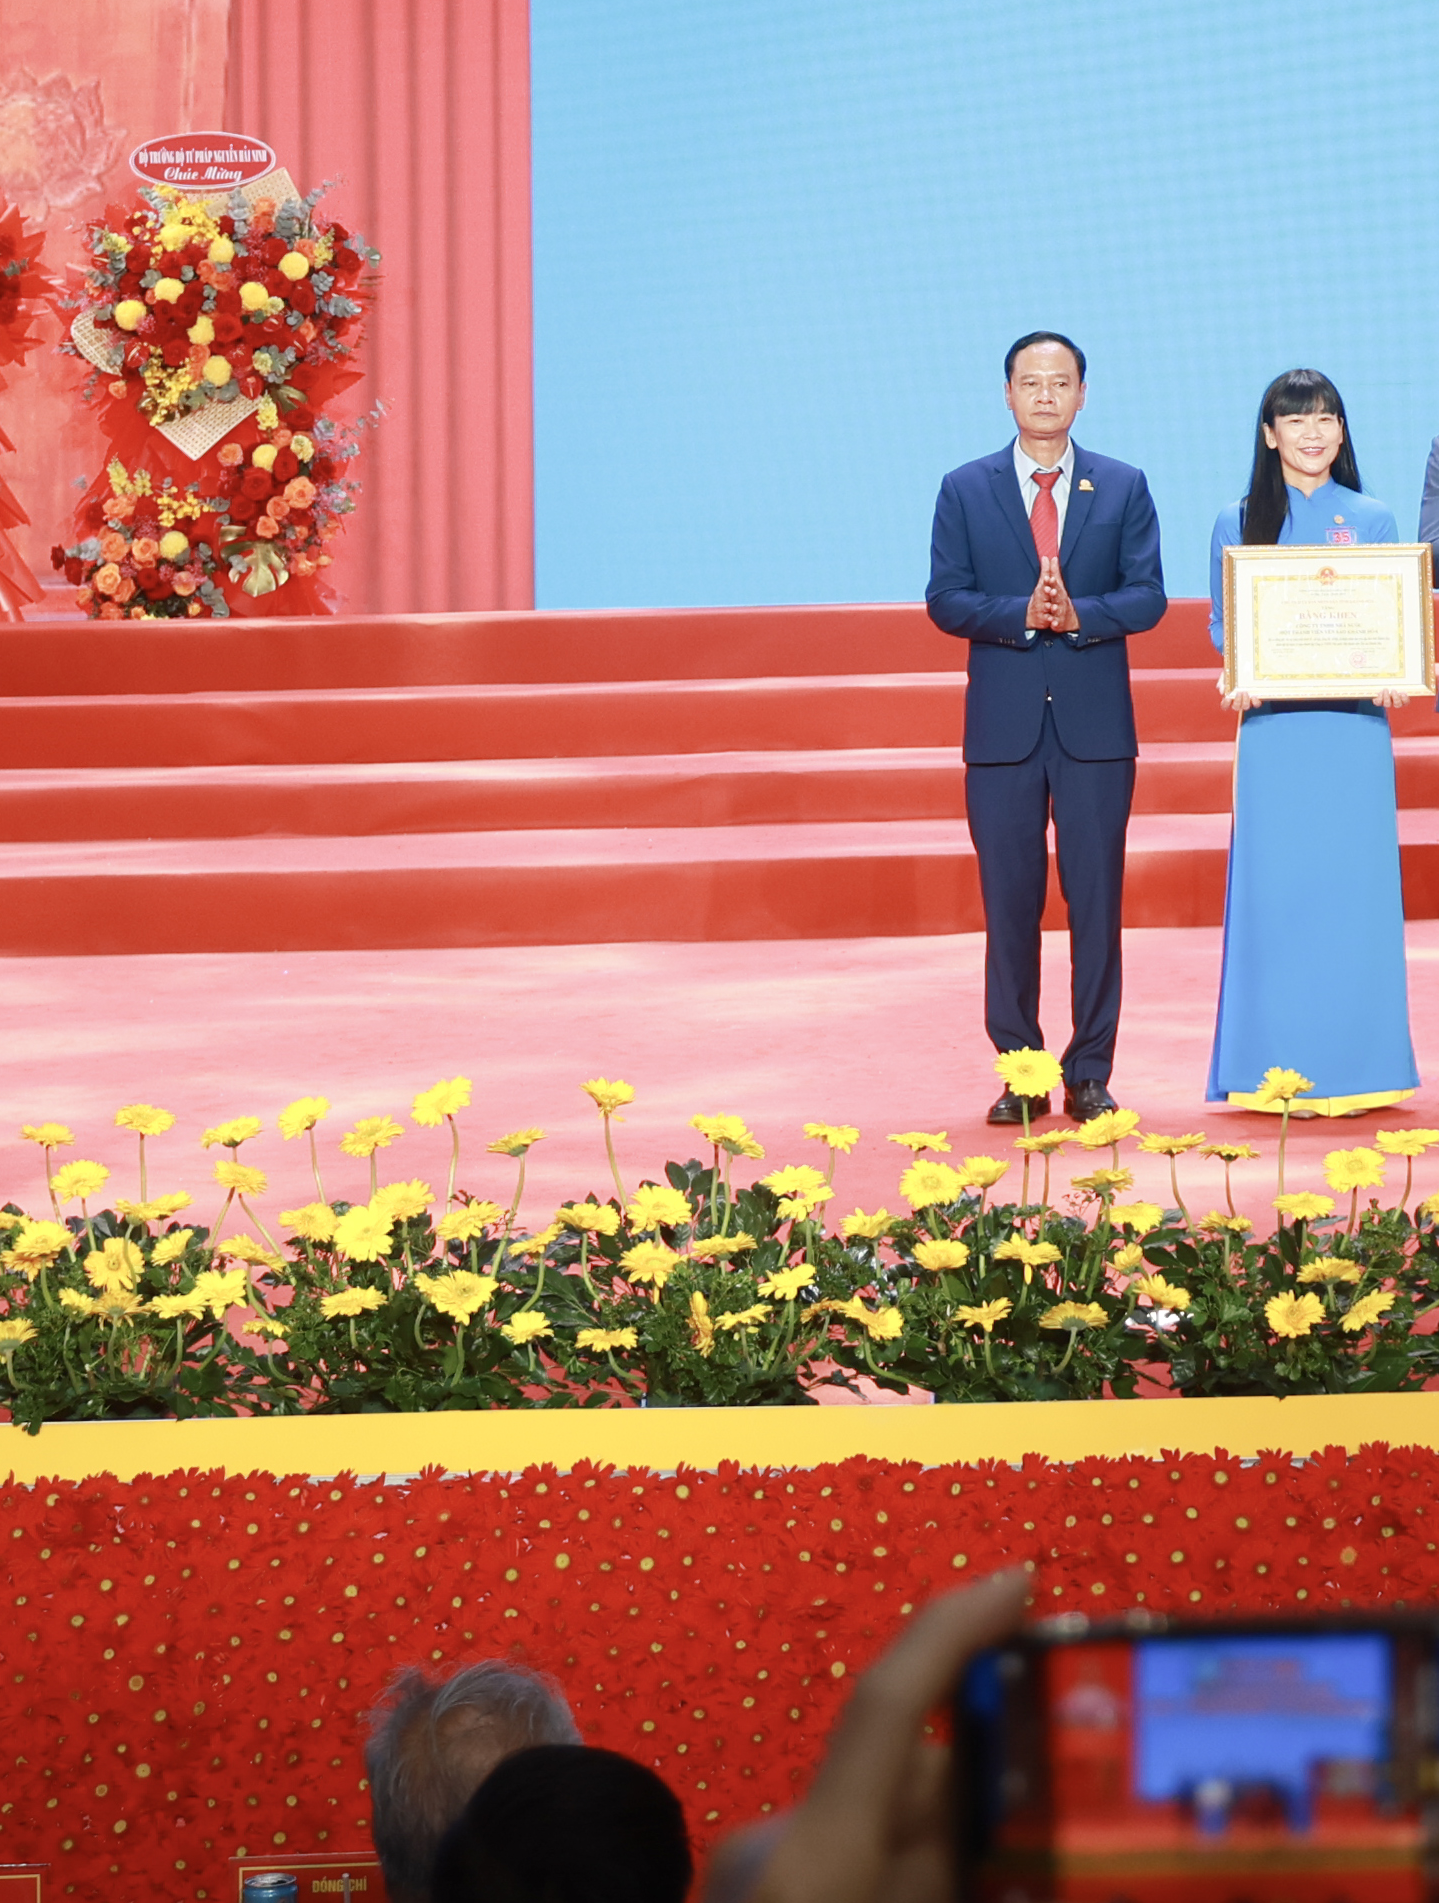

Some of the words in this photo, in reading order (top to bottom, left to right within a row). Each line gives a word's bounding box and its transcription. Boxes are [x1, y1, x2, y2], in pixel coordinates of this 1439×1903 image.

[164, 166, 199, 180] Chúc
[201, 166, 243, 182] Mừng
[1333, 531, 1350, 543] 35
[348, 1876, 367, 1892] CHÍ
